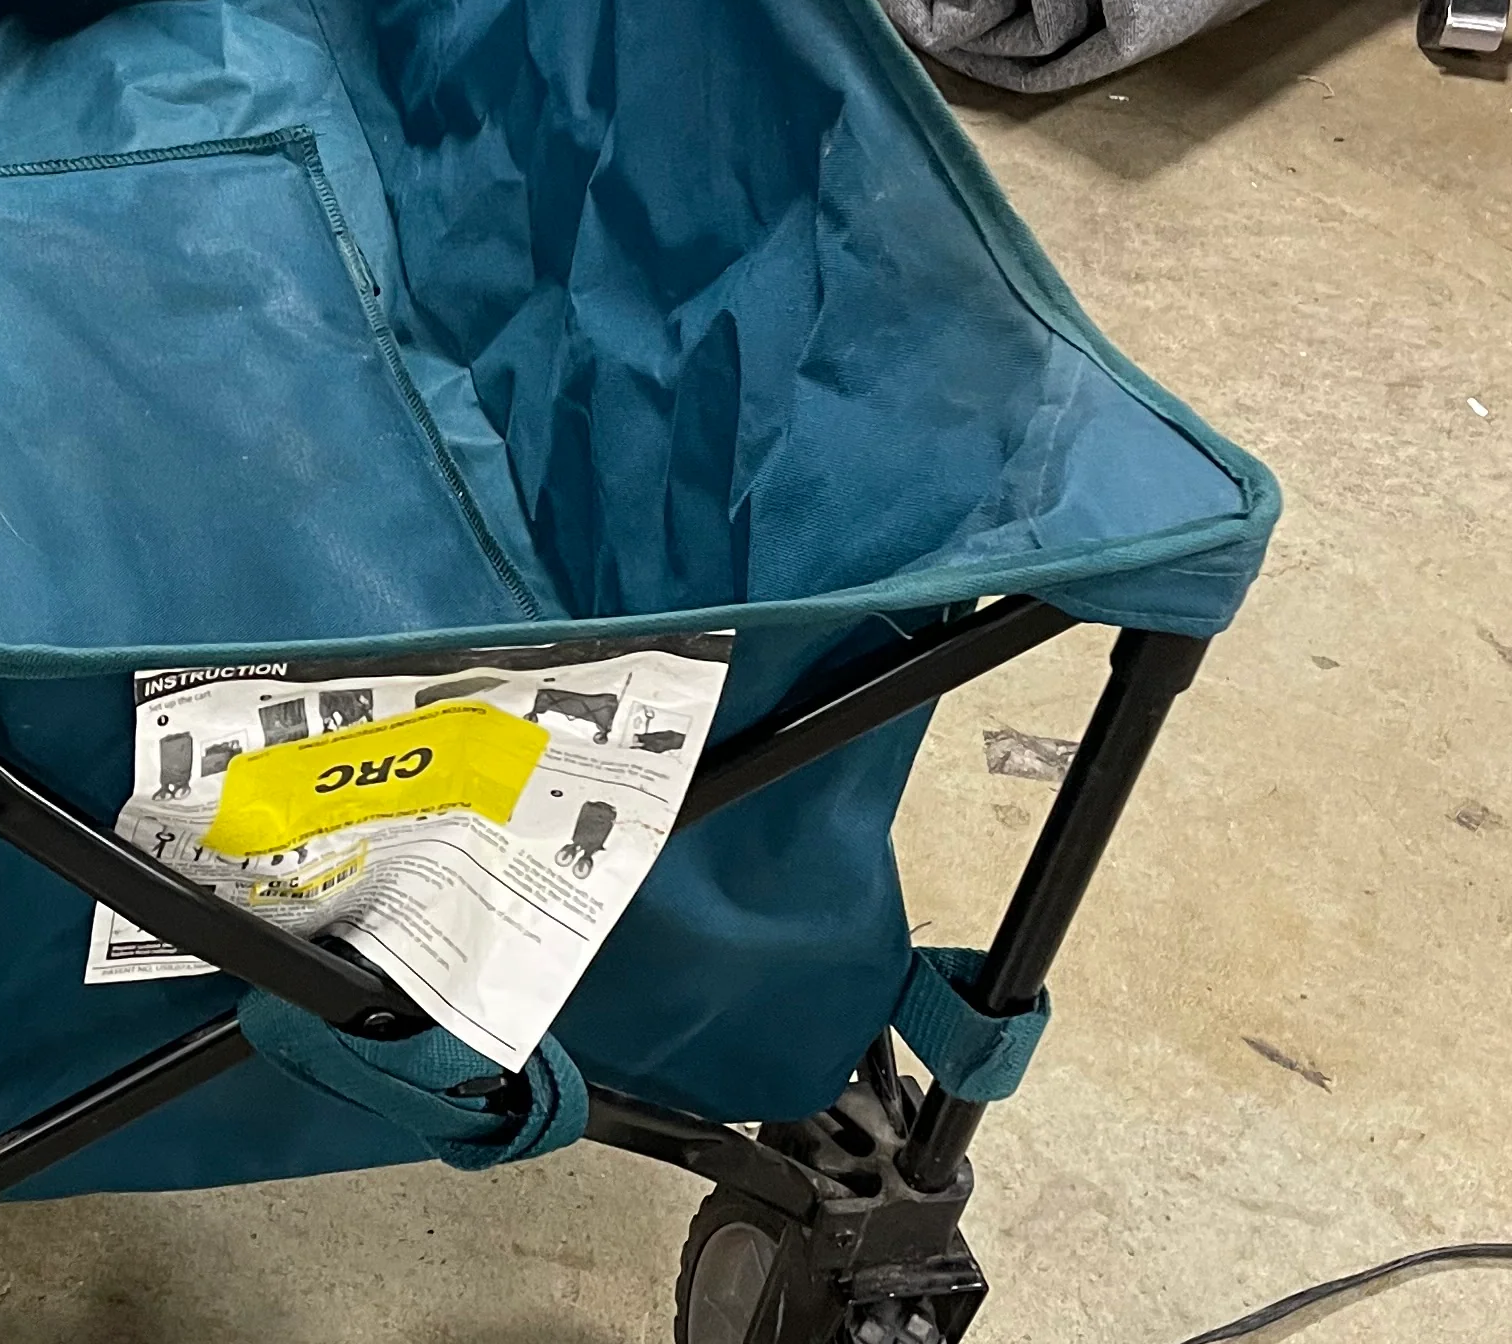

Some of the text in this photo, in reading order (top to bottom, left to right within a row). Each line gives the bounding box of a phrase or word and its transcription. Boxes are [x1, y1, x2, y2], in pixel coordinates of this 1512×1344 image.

[143, 662, 288, 698] INSTRUCTION
[177, 694, 193, 705] the
[194, 690, 213, 702] cart
[314, 746, 434, 795] CRC
